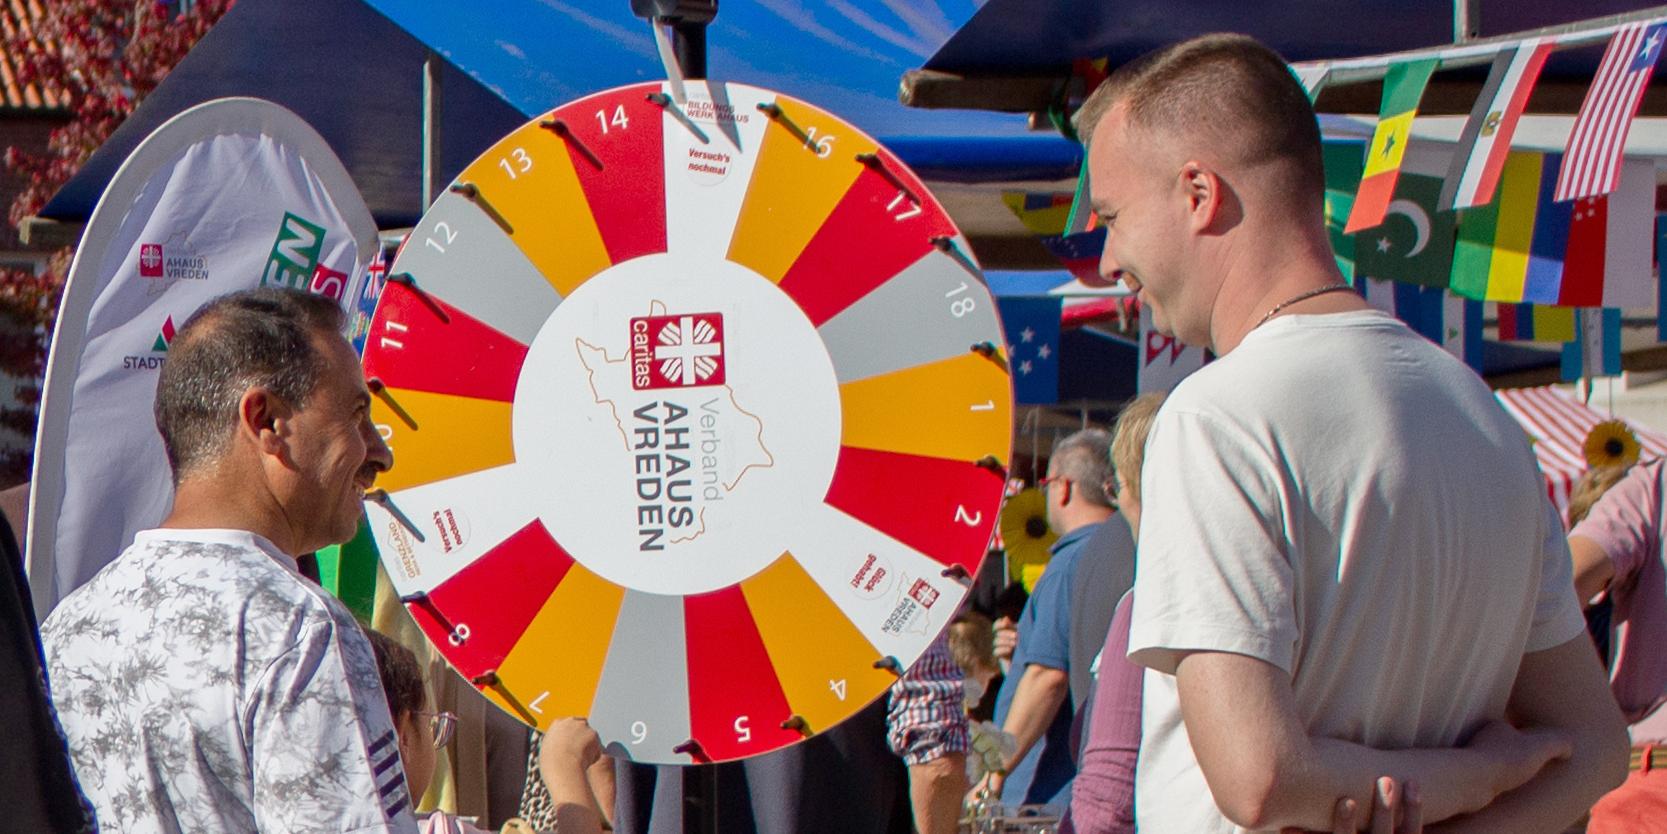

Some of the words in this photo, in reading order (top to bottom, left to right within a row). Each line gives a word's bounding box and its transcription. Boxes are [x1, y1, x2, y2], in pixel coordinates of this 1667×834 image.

[595, 105, 629, 135] 14
[687, 109, 714, 119] WERK
[717, 112, 750, 123] AHAUS
[688, 148, 731, 163] Versuch's
[803, 127, 835, 158] 16
[500, 148, 532, 180] 13
[687, 162, 727, 176] nochmal
[887, 190, 922, 221] 17
[425, 221, 458, 253] 12
[166, 257, 204, 269] AHAUS
[166, 268, 209, 280] VREDEN
[946, 281, 975, 318] 18
[381, 320, 408, 349] 11
[633, 319, 651, 388] caritas
[970, 400, 995, 412] 1
[699, 398, 724, 501] Verband
[633, 401, 665, 551] VREDEN
[663, 401, 694, 528] AHAUS
[443, 508, 463, 545] nochmal
[954, 504, 981, 527] 2
[881, 597, 909, 632] VREDEN
[891, 601, 917, 633] AHAUS
[448, 623, 471, 647] 8
[529, 691, 550, 714] 7
[829, 679, 846, 701] 4
[631, 721, 647, 744] 6
[734, 716, 751, 743] 5
